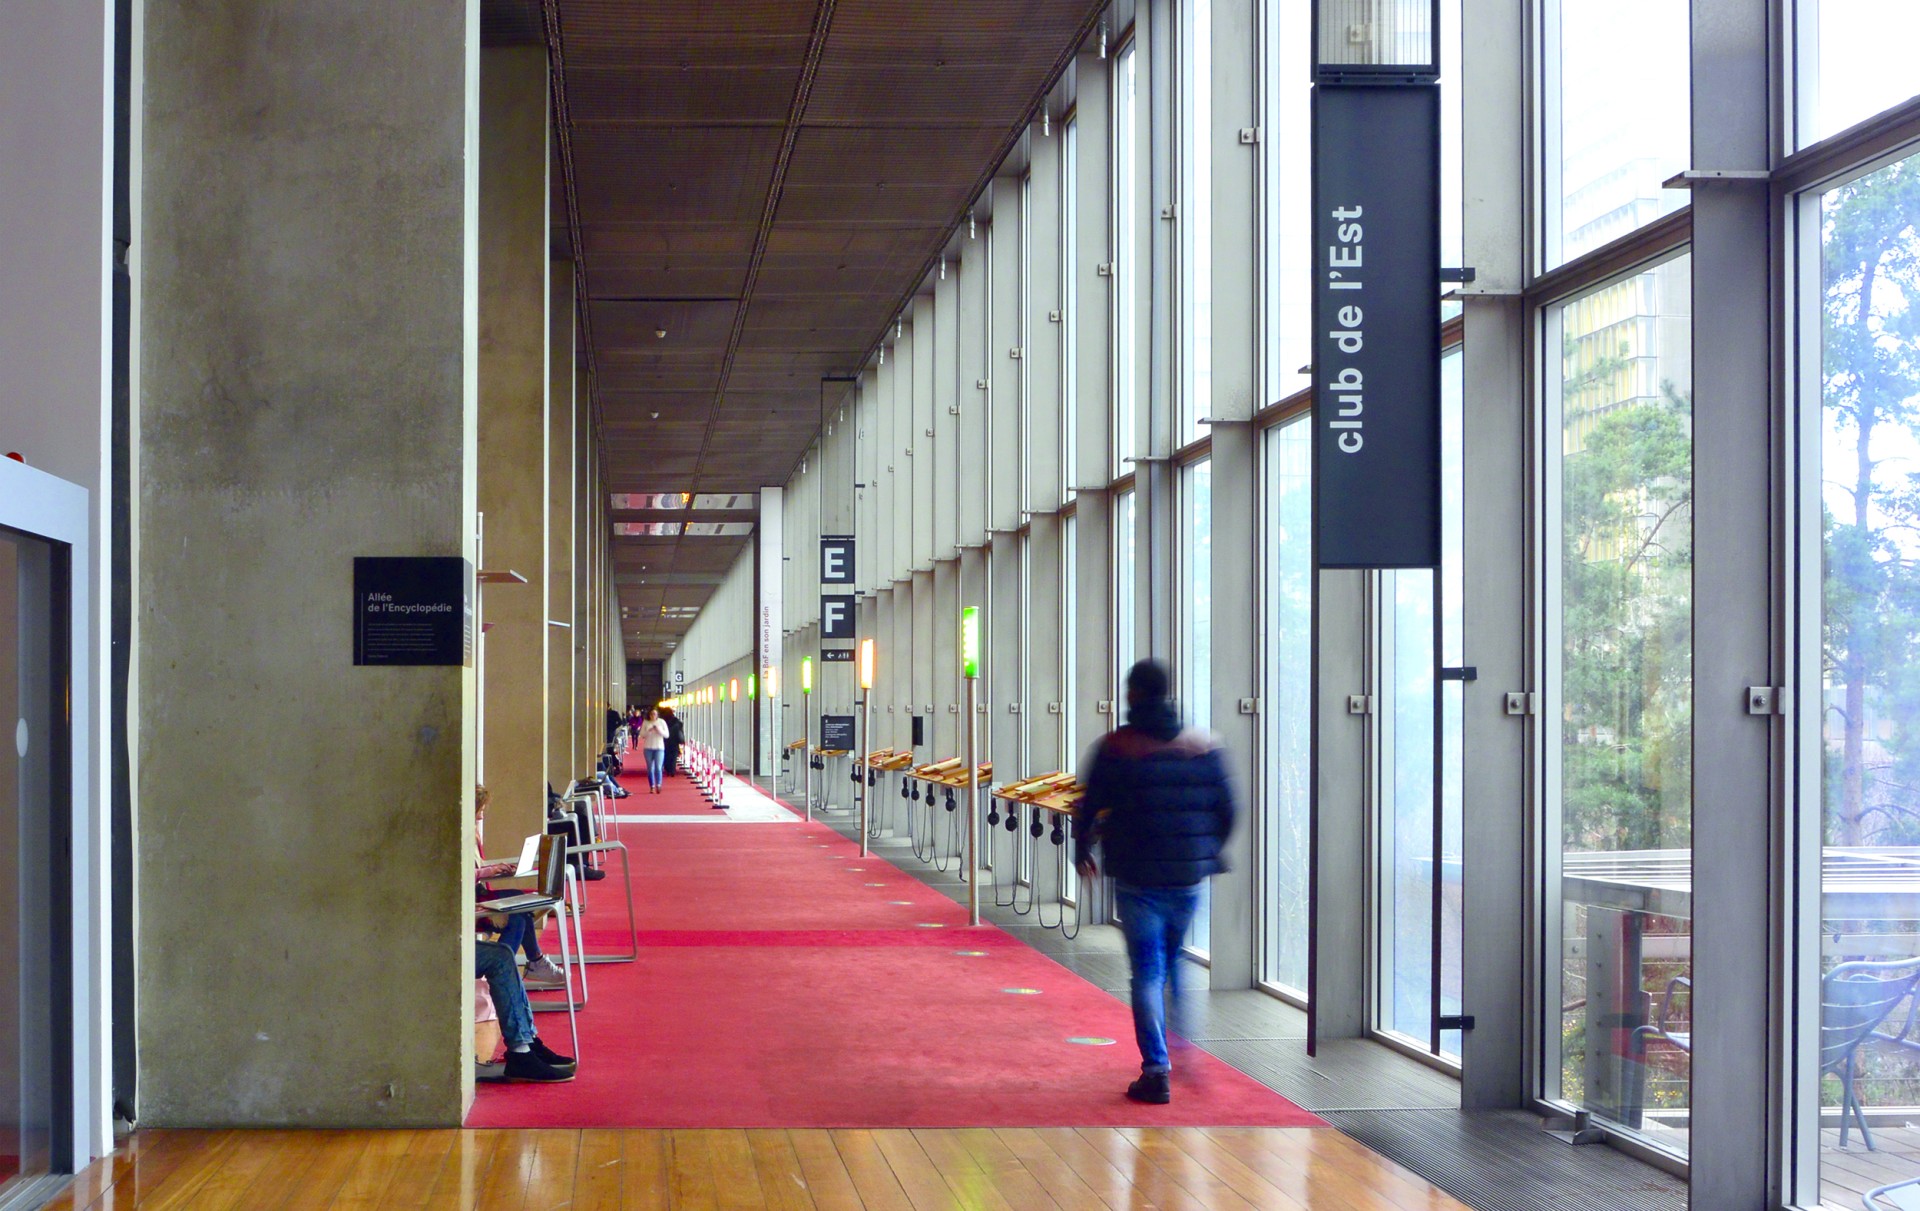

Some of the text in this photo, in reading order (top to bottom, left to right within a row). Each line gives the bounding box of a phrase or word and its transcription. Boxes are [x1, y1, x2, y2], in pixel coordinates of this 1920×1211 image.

[1329, 205, 1363, 454] club de l'Est
[825, 547, 845, 578] E
[368, 592, 392, 601] Allée
[368, 603, 452, 614] de l'Encyclopédie
[762, 606, 771, 627] jardin
[825, 602, 845, 632] F
[675, 673, 682, 681] G
[675, 685, 682, 693] H
